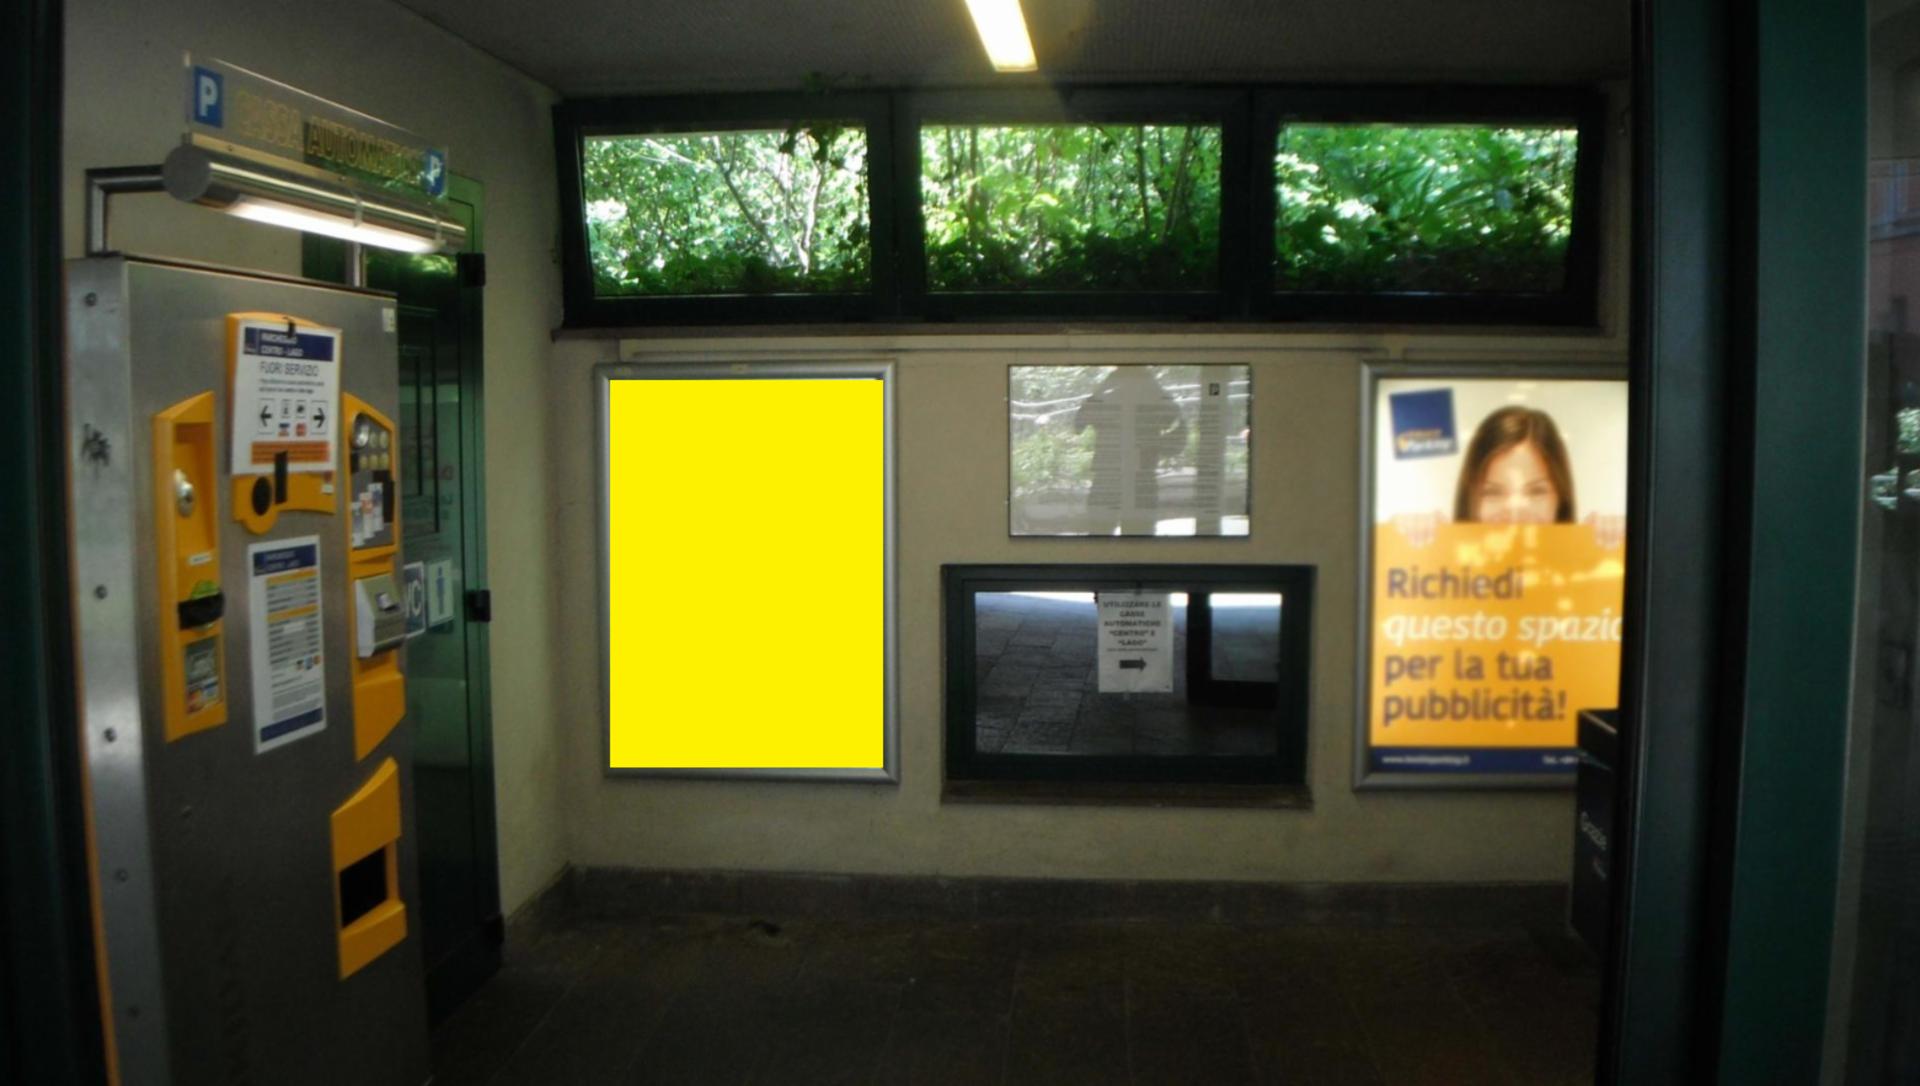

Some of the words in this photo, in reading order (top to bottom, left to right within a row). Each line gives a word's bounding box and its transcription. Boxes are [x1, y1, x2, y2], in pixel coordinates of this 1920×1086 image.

[199, 75, 218, 118] P
[426, 153, 442, 188] P
[260, 361, 282, 375] FUORI
[1387, 567, 1523, 600] Richiedi
[1103, 601, 1149, 609] UTILIZZARE
[1151, 601, 1162, 609] LE
[1119, 610, 1145, 618] CASSE
[1384, 611, 1507, 647] questo
[1384, 654, 1440, 686] per
[1455, 649, 1485, 680] la
[1497, 653, 1554, 681] tua
[1383, 688, 1567, 727] pubblicità!
